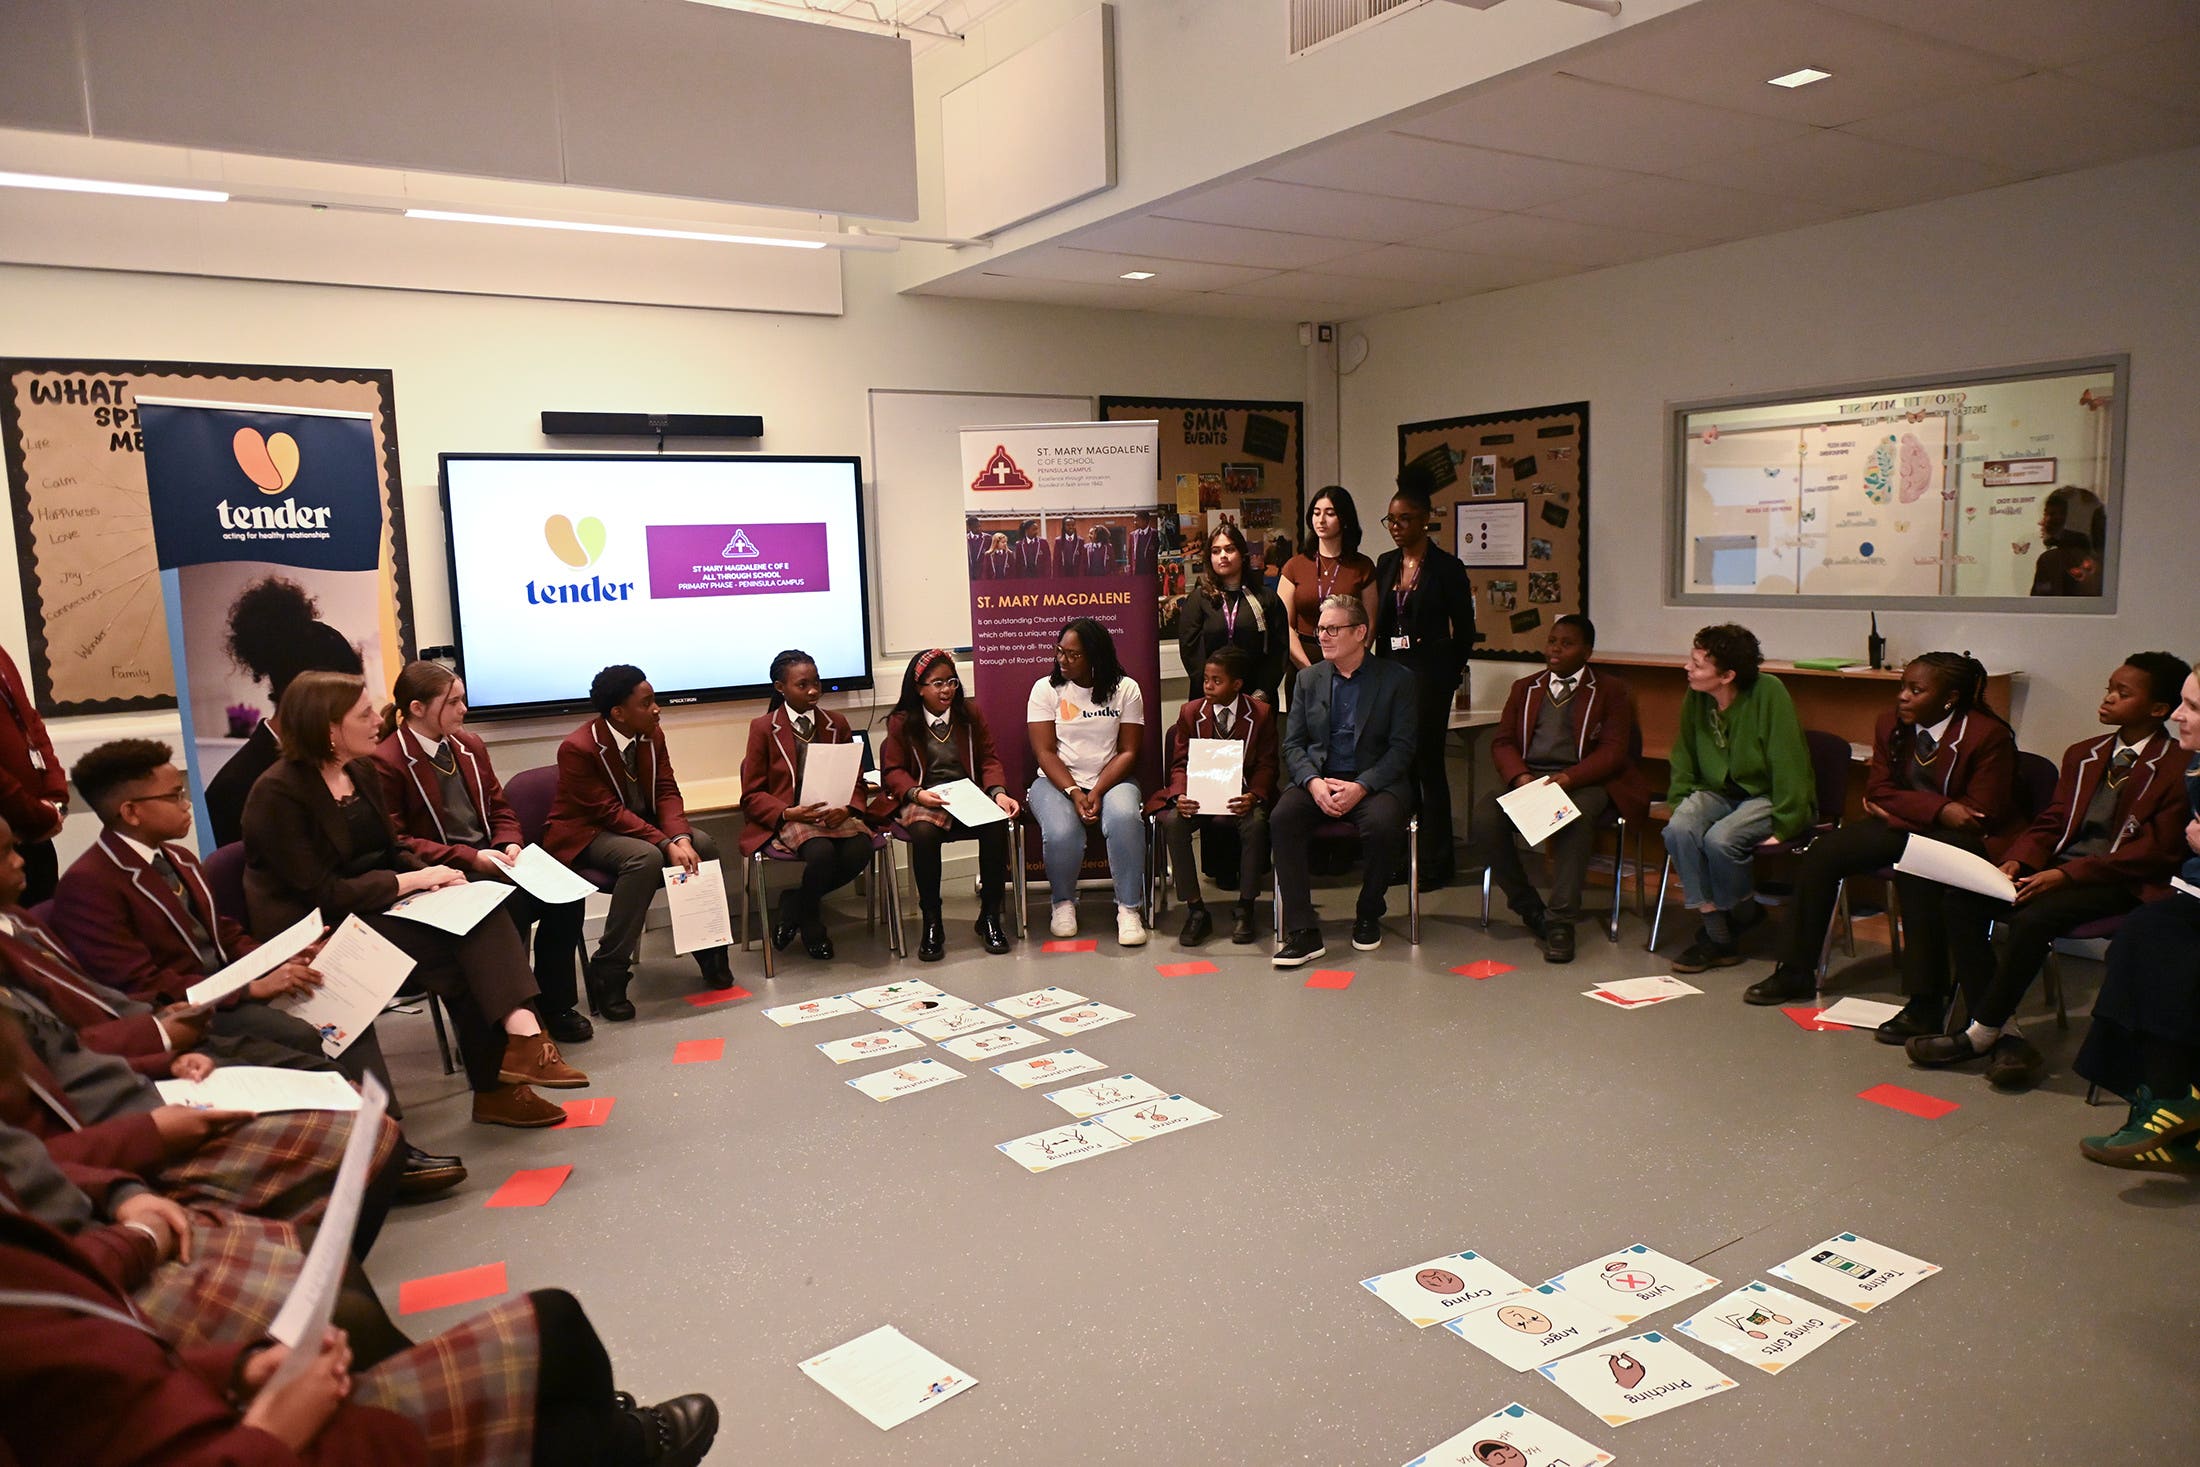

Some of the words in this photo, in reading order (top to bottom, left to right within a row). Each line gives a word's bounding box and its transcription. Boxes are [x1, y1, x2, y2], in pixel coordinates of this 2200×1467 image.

[30, 379, 128, 405] WHAT
[94, 407, 141, 429] SPI
[1183, 410, 1228, 431] SMM
[110, 431, 144, 452] ME
[1184, 432, 1228, 445] EVENTS
[1037, 447, 1051, 456] ST.
[1055, 447, 1083, 455] MARY
[1086, 445, 1150, 455] MAGDALENE
[1064, 457, 1095, 465] SCHOOL
[42, 476, 77, 488] Calm
[216, 497, 331, 529] tender
[49, 530, 80, 545] Love
[223, 532, 246, 541] acting
[258, 532, 285, 540] healthy
[286, 531, 330, 540] relationships
[692, 565, 702, 573] ST
[725, 563, 767, 571] MAGDALENE
[60, 571, 82, 587] Joy
[702, 573, 716, 581] ALL
[717, 572, 751, 580] THROUGH
[752, 571, 781, 579] SCHOOL
[526, 575, 634, 605] tender
[678, 582, 709, 590] PRIMARY
[710, 581, 733, 589] PHASE
[739, 580, 776, 588] PENINSULA
[977, 596, 994, 609] ST.
[998, 594, 1039, 608] MARY
[1043, 592, 1131, 606] MAGDALENE
[993, 617, 1033, 625] outstanding
[1033, 616, 1058, 624] Church
[999, 630, 1017, 638] offers
[1024, 630, 1047, 638] unique
[986, 645, 999, 653] join
[979, 658, 1008, 666] borough
[111, 665, 151, 683] Family
[860, 1044, 898, 1055] Arguing
[1031, 1065, 1087, 1081] Selfishness
[894, 1076, 939, 1092] Shouting
[1096, 1094, 1136, 1107] Kicking
[1149, 1116, 1189, 1130] Control
[1046, 1143, 1103, 1161] Following
[1858, 1269, 1905, 1291] Texting
[1441, 1289, 1492, 1308] Crying
[1636, 1284, 1675, 1301] Lying
[1541, 1326, 1579, 1347] Anger
[1784, 1318, 1824, 1340] Giving
[1761, 1338, 1793, 1356] Gifts
[1624, 1378, 1692, 1404] Pinching
[1496, 1430, 1514, 1441] HA
[1522, 1446, 1541, 1455] HA
[1456, 1455, 1475, 1465] HA
